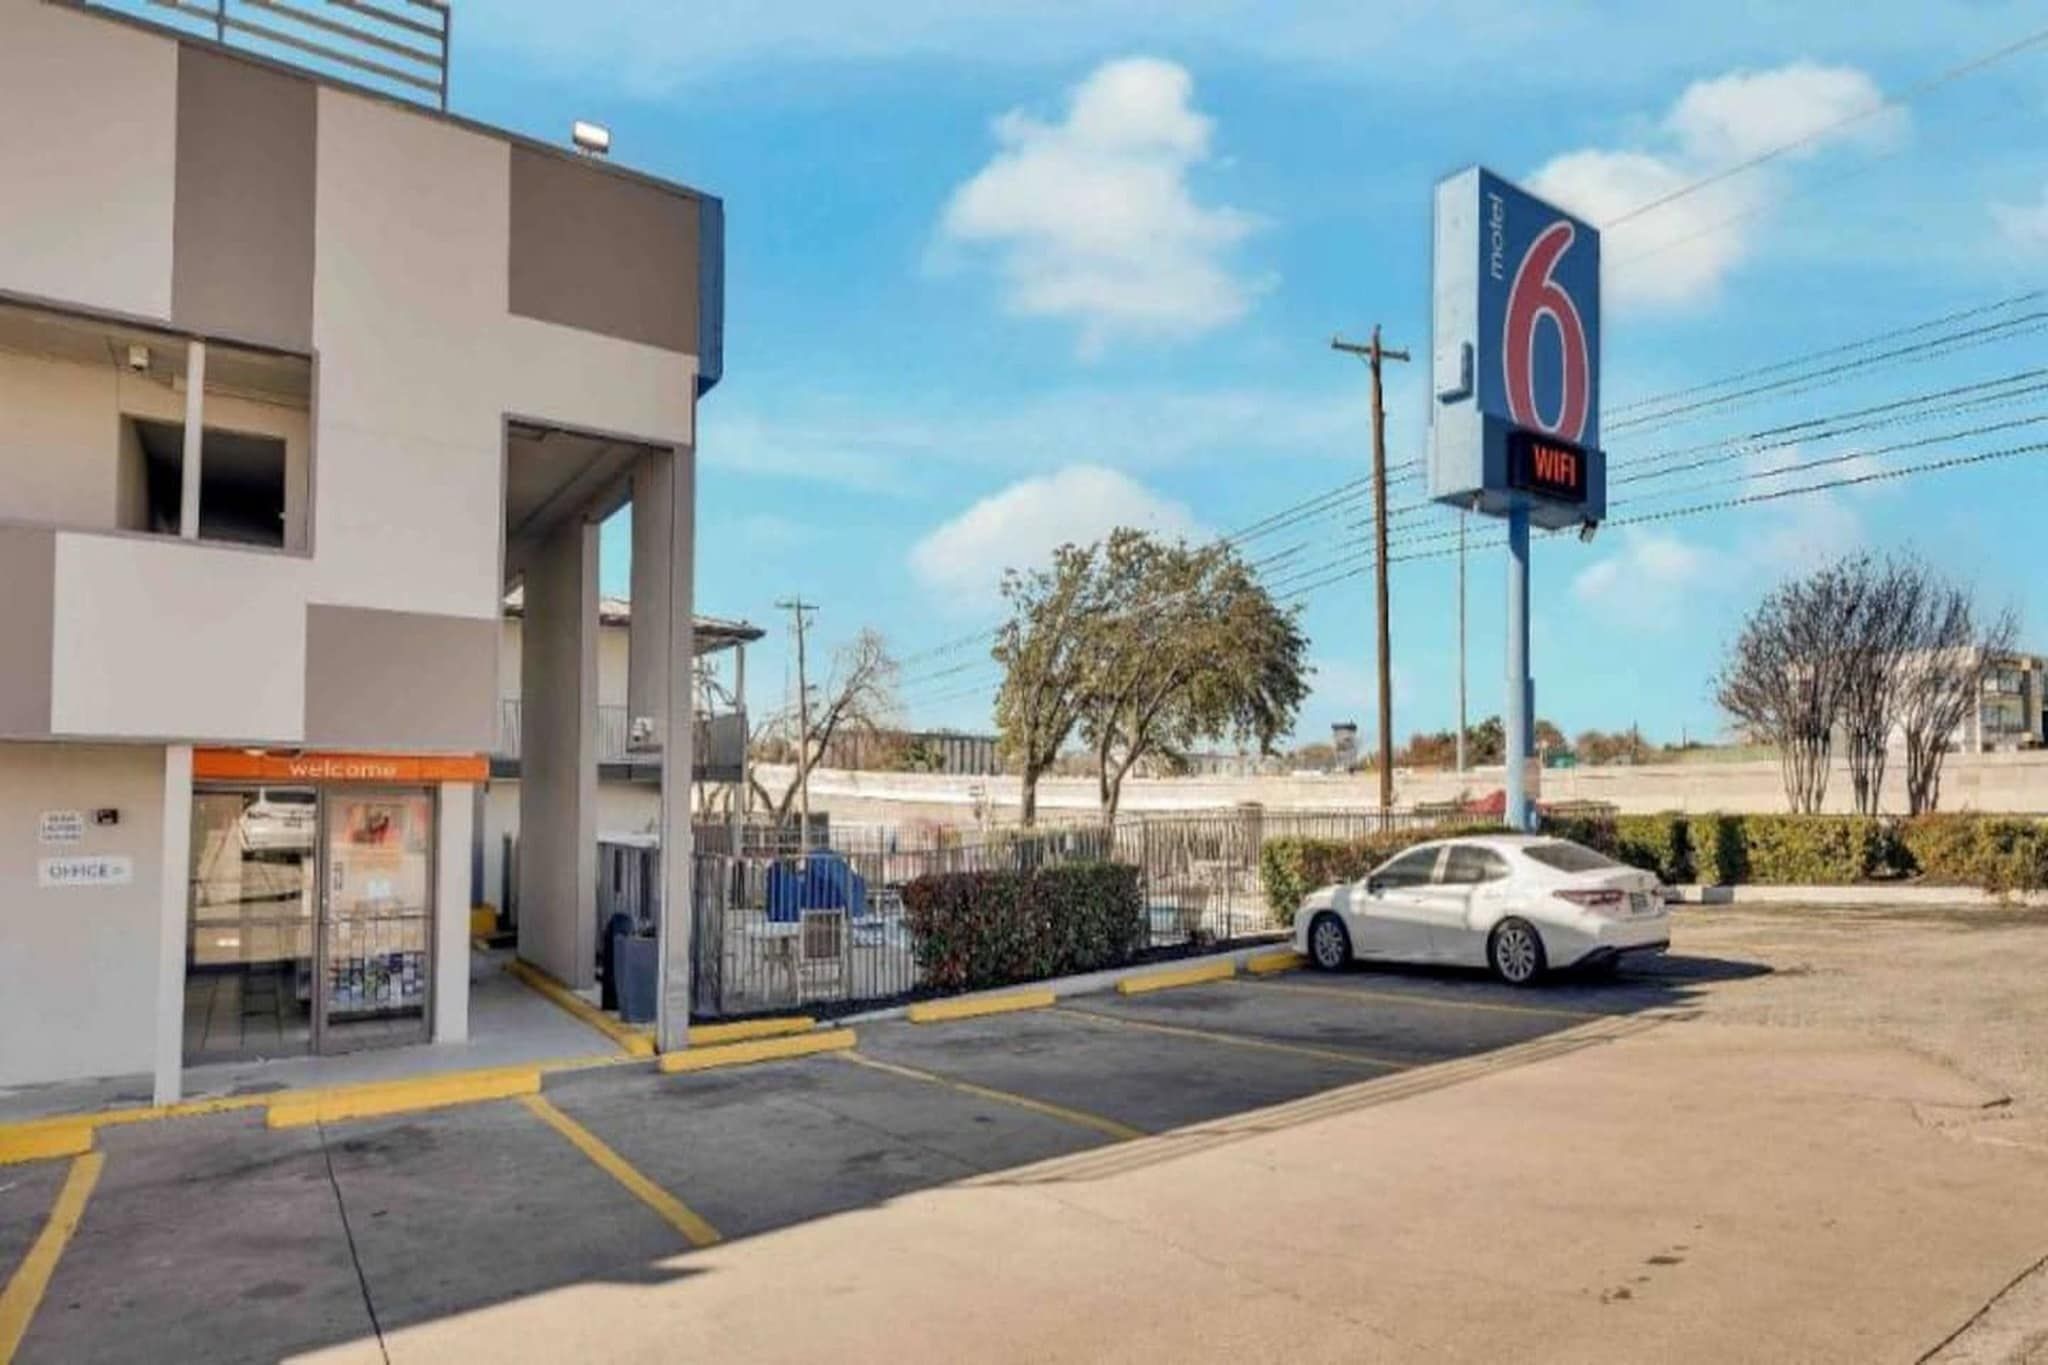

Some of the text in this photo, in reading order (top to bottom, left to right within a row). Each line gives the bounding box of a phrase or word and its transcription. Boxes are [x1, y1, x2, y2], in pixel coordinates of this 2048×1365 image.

[1488, 192, 1504, 280] motel
[1503, 219, 1590, 445] 6
[289, 760, 397, 778] welcome
[49, 862, 110, 879] OFFICE
